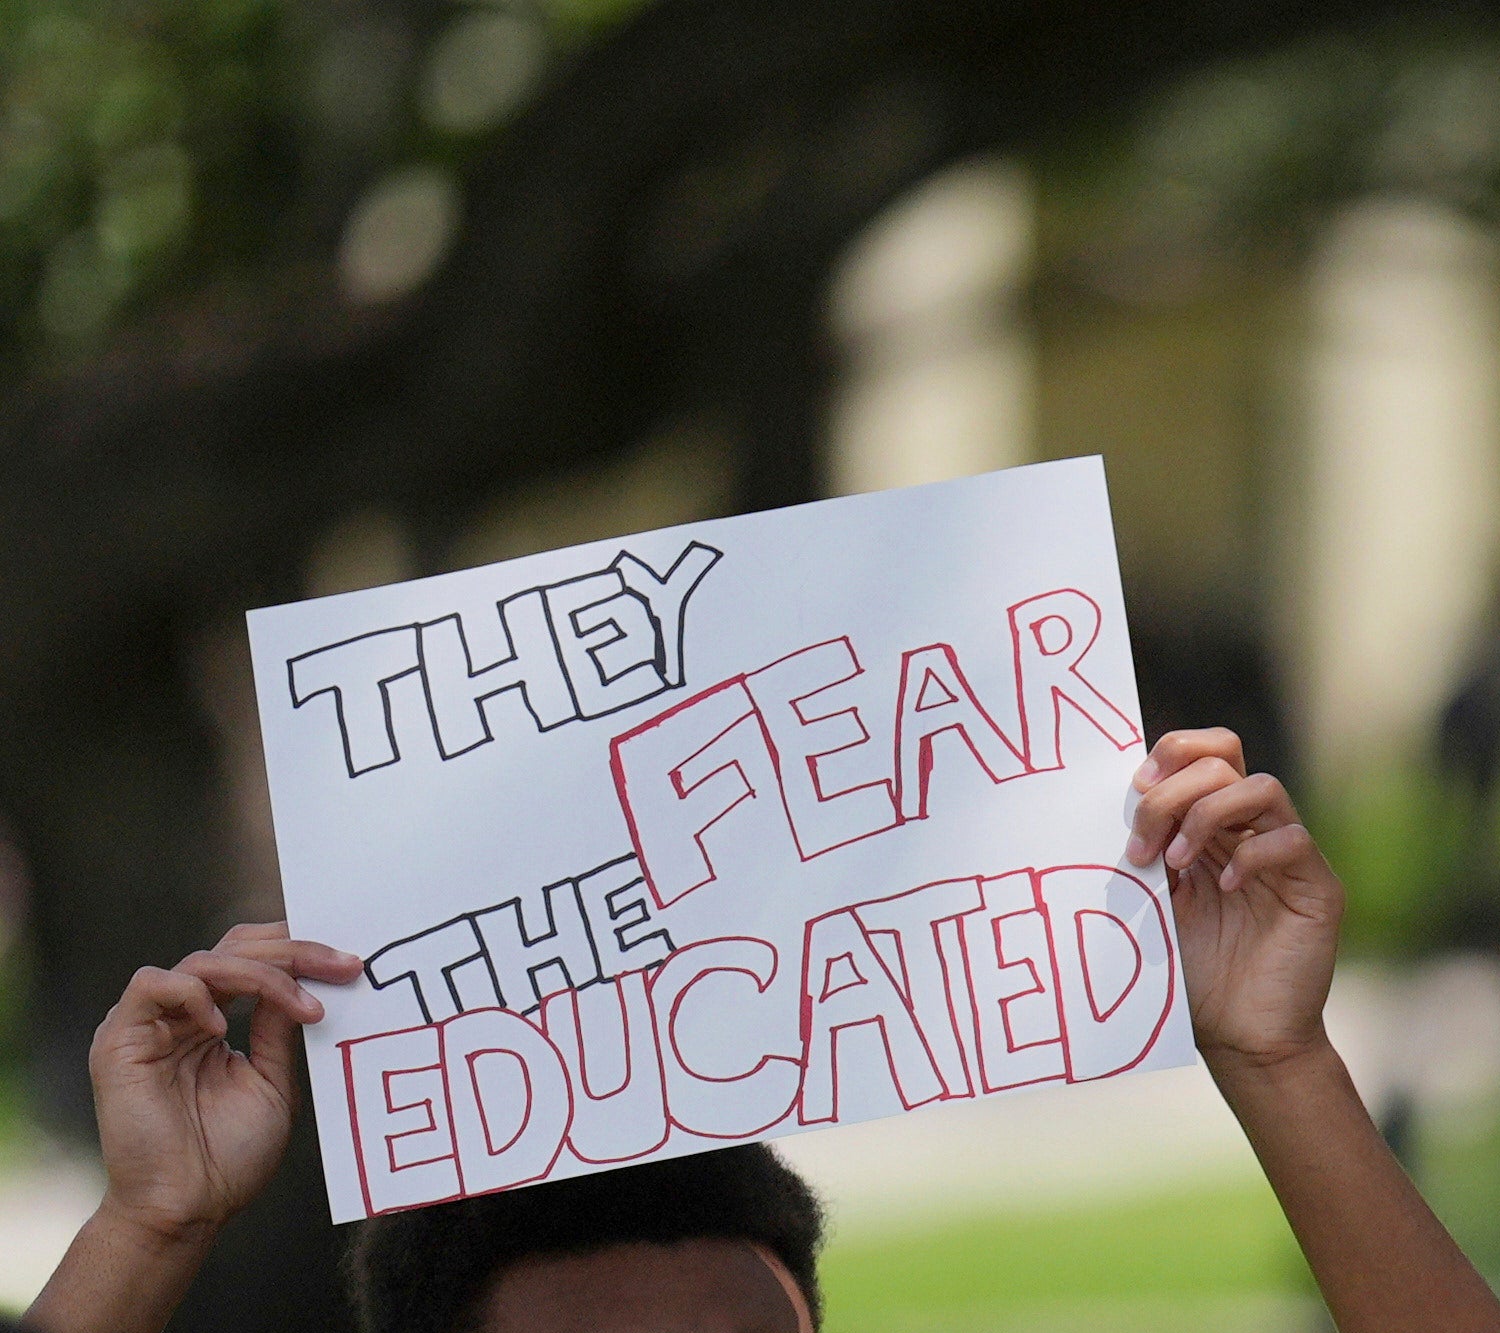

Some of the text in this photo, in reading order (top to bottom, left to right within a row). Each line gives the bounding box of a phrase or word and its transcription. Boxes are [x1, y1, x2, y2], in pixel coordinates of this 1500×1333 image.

[288, 542, 724, 778] THEY
[610, 589, 1142, 909] FEAR
[336, 864, 1176, 1216] EDUCATED
[363, 851, 677, 1024] THE
